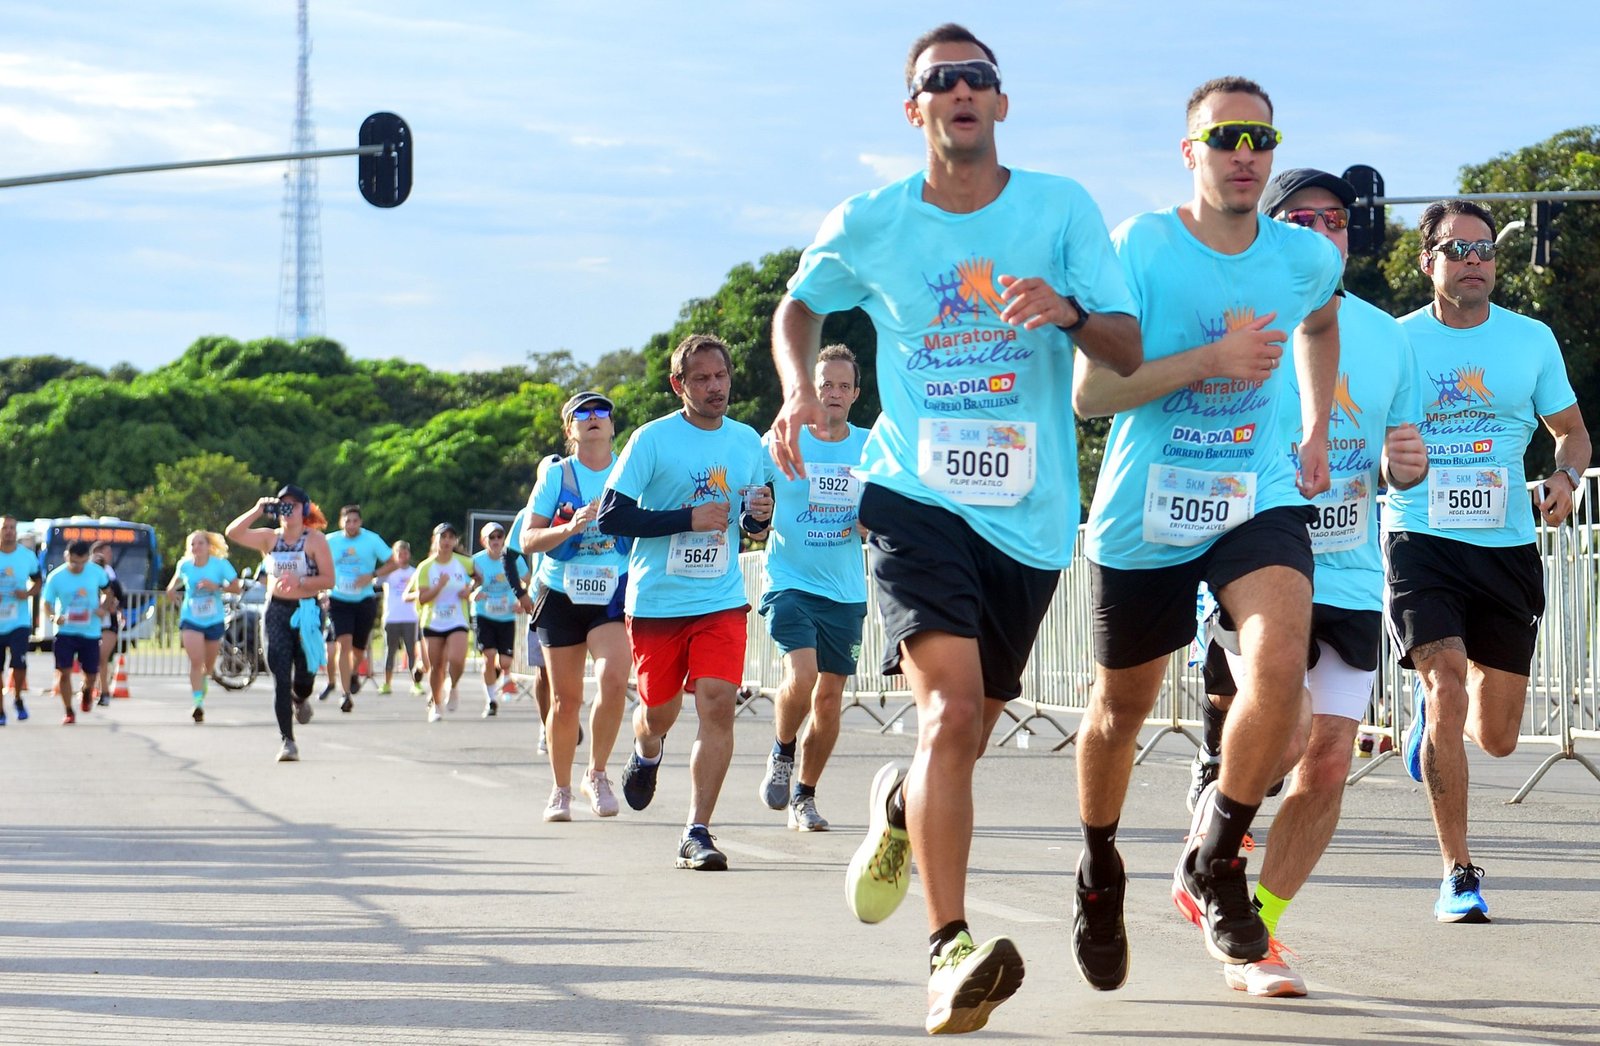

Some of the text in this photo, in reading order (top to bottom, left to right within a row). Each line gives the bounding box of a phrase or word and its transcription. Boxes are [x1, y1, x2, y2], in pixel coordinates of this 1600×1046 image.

[923, 328, 1017, 351] Maratona
[906, 340, 1035, 371] Brasília
[923, 394, 1020, 412] CORREIO BRAZILIENSE
[1161, 388, 1271, 417] Brasília
[1426, 410, 1496, 422] Maratona
[1415, 416, 1507, 435] Brasília
[960, 429, 980, 441] 5KM
[1162, 443, 1205, 459] CORREIO
[1291, 437, 1366, 453] Matona
[946, 450, 1009, 478] 5060
[1453, 456, 1497, 465] BRAZILIENSE
[819, 477, 849, 492] 5922
[949, 478, 1003, 487] FILIPE INTÁTILO
[1186, 479, 1205, 490] 5KM
[1456, 474, 1472, 483] 5KM
[1448, 489, 1491, 509] 5601
[1170, 496, 1230, 523] 5050
[1169, 522, 1227, 531] ERIVELTON ALVES
[1330, 528, 1356, 536] RIGHETTO
[684, 548, 719, 564] 5647
[576, 578, 607, 592] 5606
